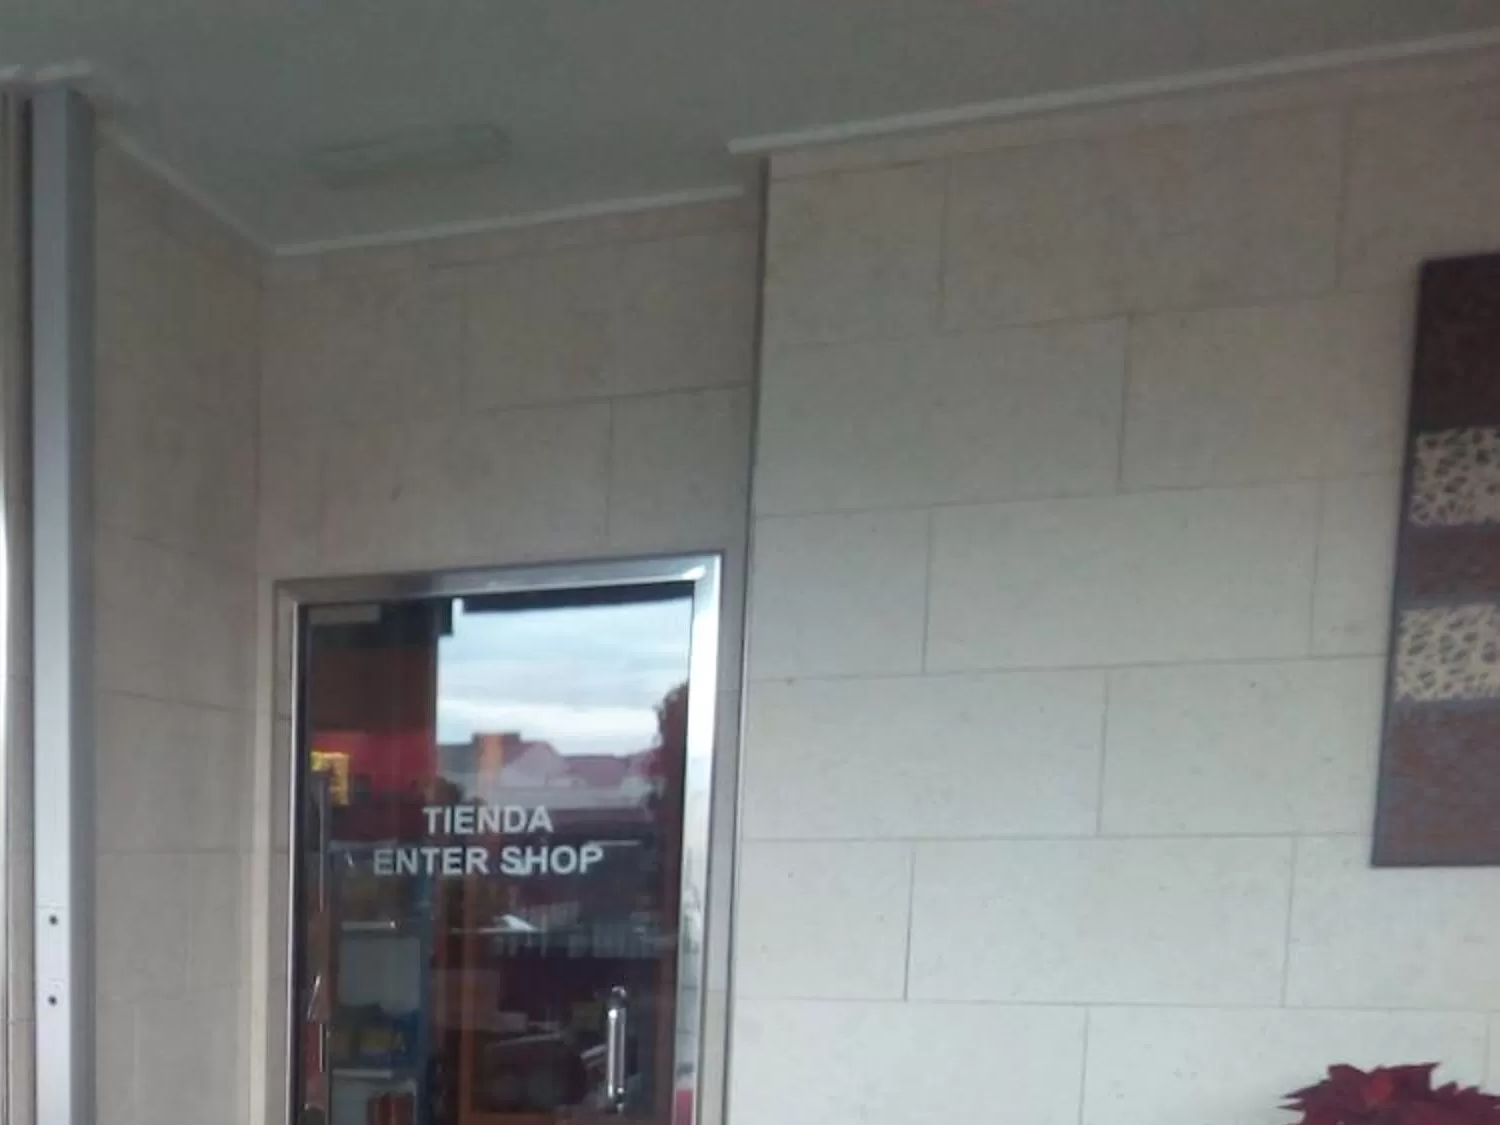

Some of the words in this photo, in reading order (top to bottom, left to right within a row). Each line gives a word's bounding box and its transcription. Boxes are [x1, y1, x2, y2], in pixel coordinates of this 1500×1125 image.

[422, 804, 555, 836] TIENDA
[373, 846, 490, 876] ENTER
[500, 845, 605, 876] SHOP
